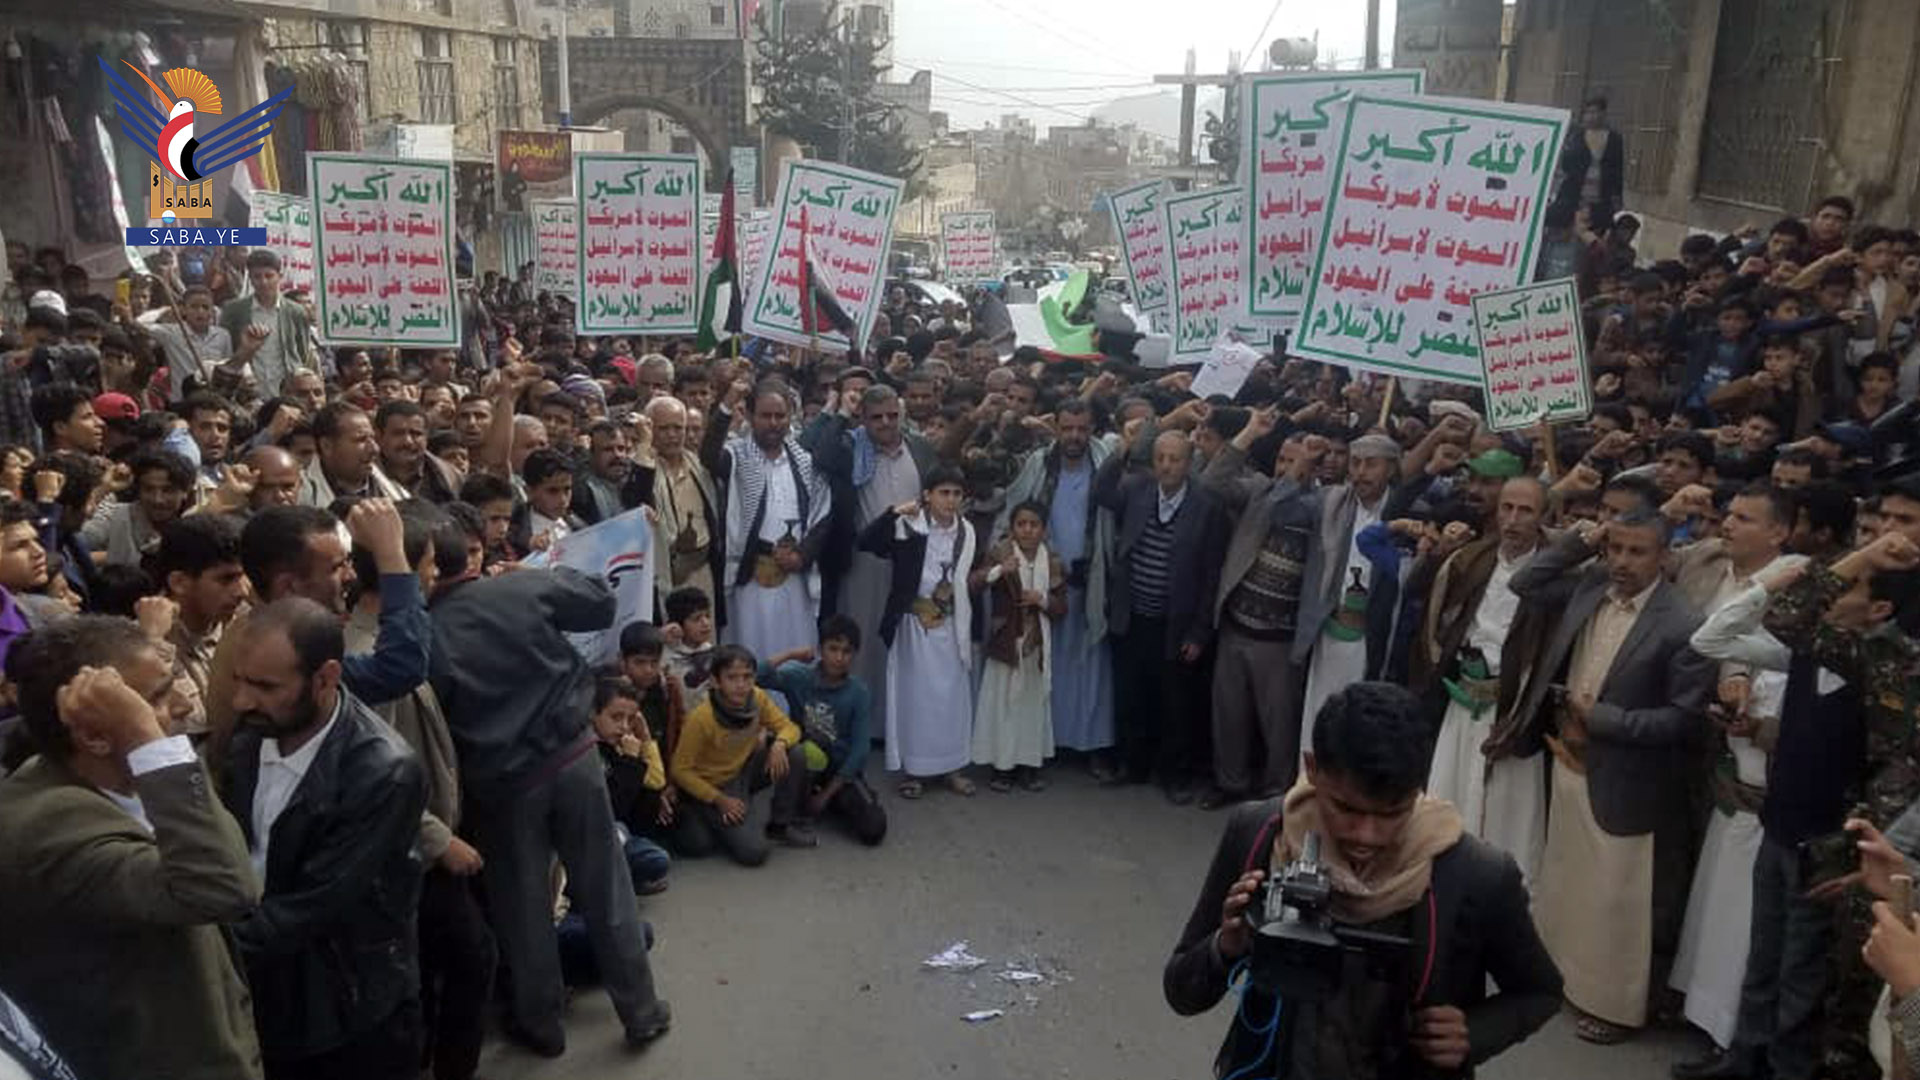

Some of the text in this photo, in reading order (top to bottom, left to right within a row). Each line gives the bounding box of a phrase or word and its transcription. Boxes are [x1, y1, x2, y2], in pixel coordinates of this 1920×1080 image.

[1262, 87, 1351, 144] كبر
[1350, 117, 1545, 174] الله أكبر
[1260, 147, 1325, 178] مريكا
[325, 168, 443, 209] الله أكبر
[588, 164, 692, 204] الله أكبر
[790, 180, 891, 218] الله أكبر
[1344, 173, 1530, 224] الموت لأمريكا
[587, 206, 643, 230] لأمريكا
[1177, 198, 1223, 240] أكبر
[1260, 186, 1324, 220] سرائيل
[324, 209, 442, 238] الموت لأمريكا
[648, 210, 692, 230] الموت
[649, 238, 692, 260] الموت
[838, 226, 883, 249] الموت
[1333, 217, 1519, 268] الموت لإسرائيل
[395, 247, 444, 268] الموت
[831, 255, 876, 276] الموت
[328, 274, 373, 298] اليهود
[378, 276, 402, 299] على
[587, 265, 626, 288] اليهود
[631, 266, 653, 288] على
[1322, 264, 1391, 297] اليهود
[1394, 273, 1434, 305] على
[331, 301, 448, 336] النصر للإسلام
[587, 290, 692, 325] النصر للإسلام
[1483, 292, 1571, 330] الله أكبر
[1311, 300, 1406, 353] للإسلام
